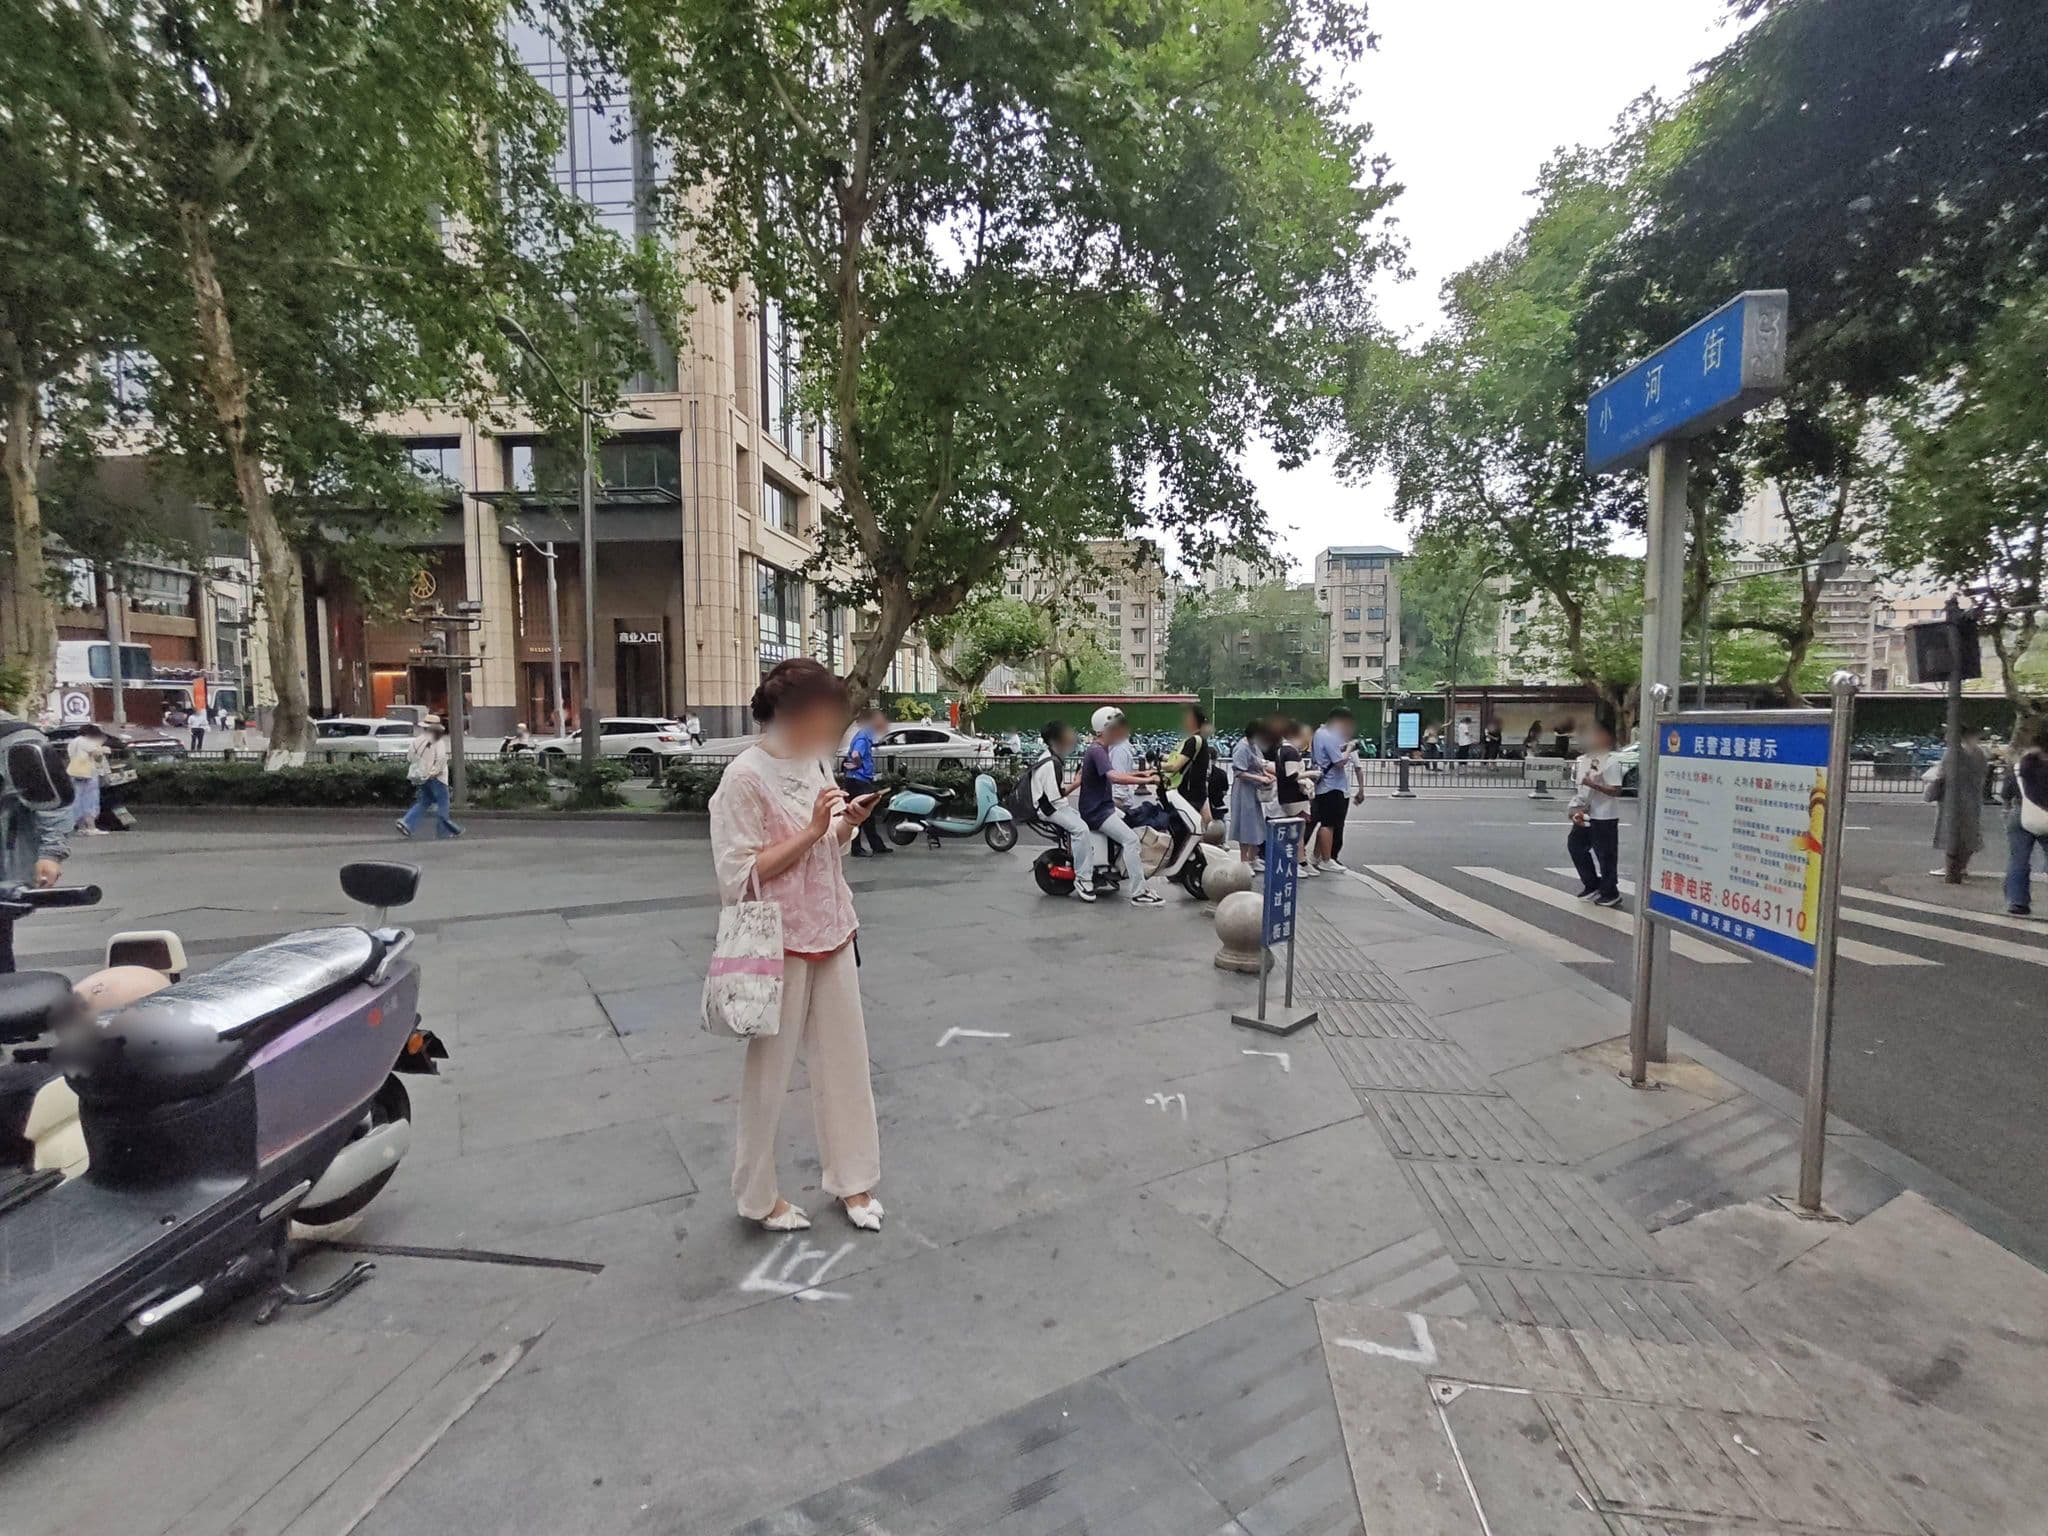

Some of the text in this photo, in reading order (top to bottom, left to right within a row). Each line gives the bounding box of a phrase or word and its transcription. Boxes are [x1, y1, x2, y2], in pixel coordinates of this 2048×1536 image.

[1600, 326, 1725, 434] 小河街
[1694, 736, 1778, 759] 民警温馨提示
